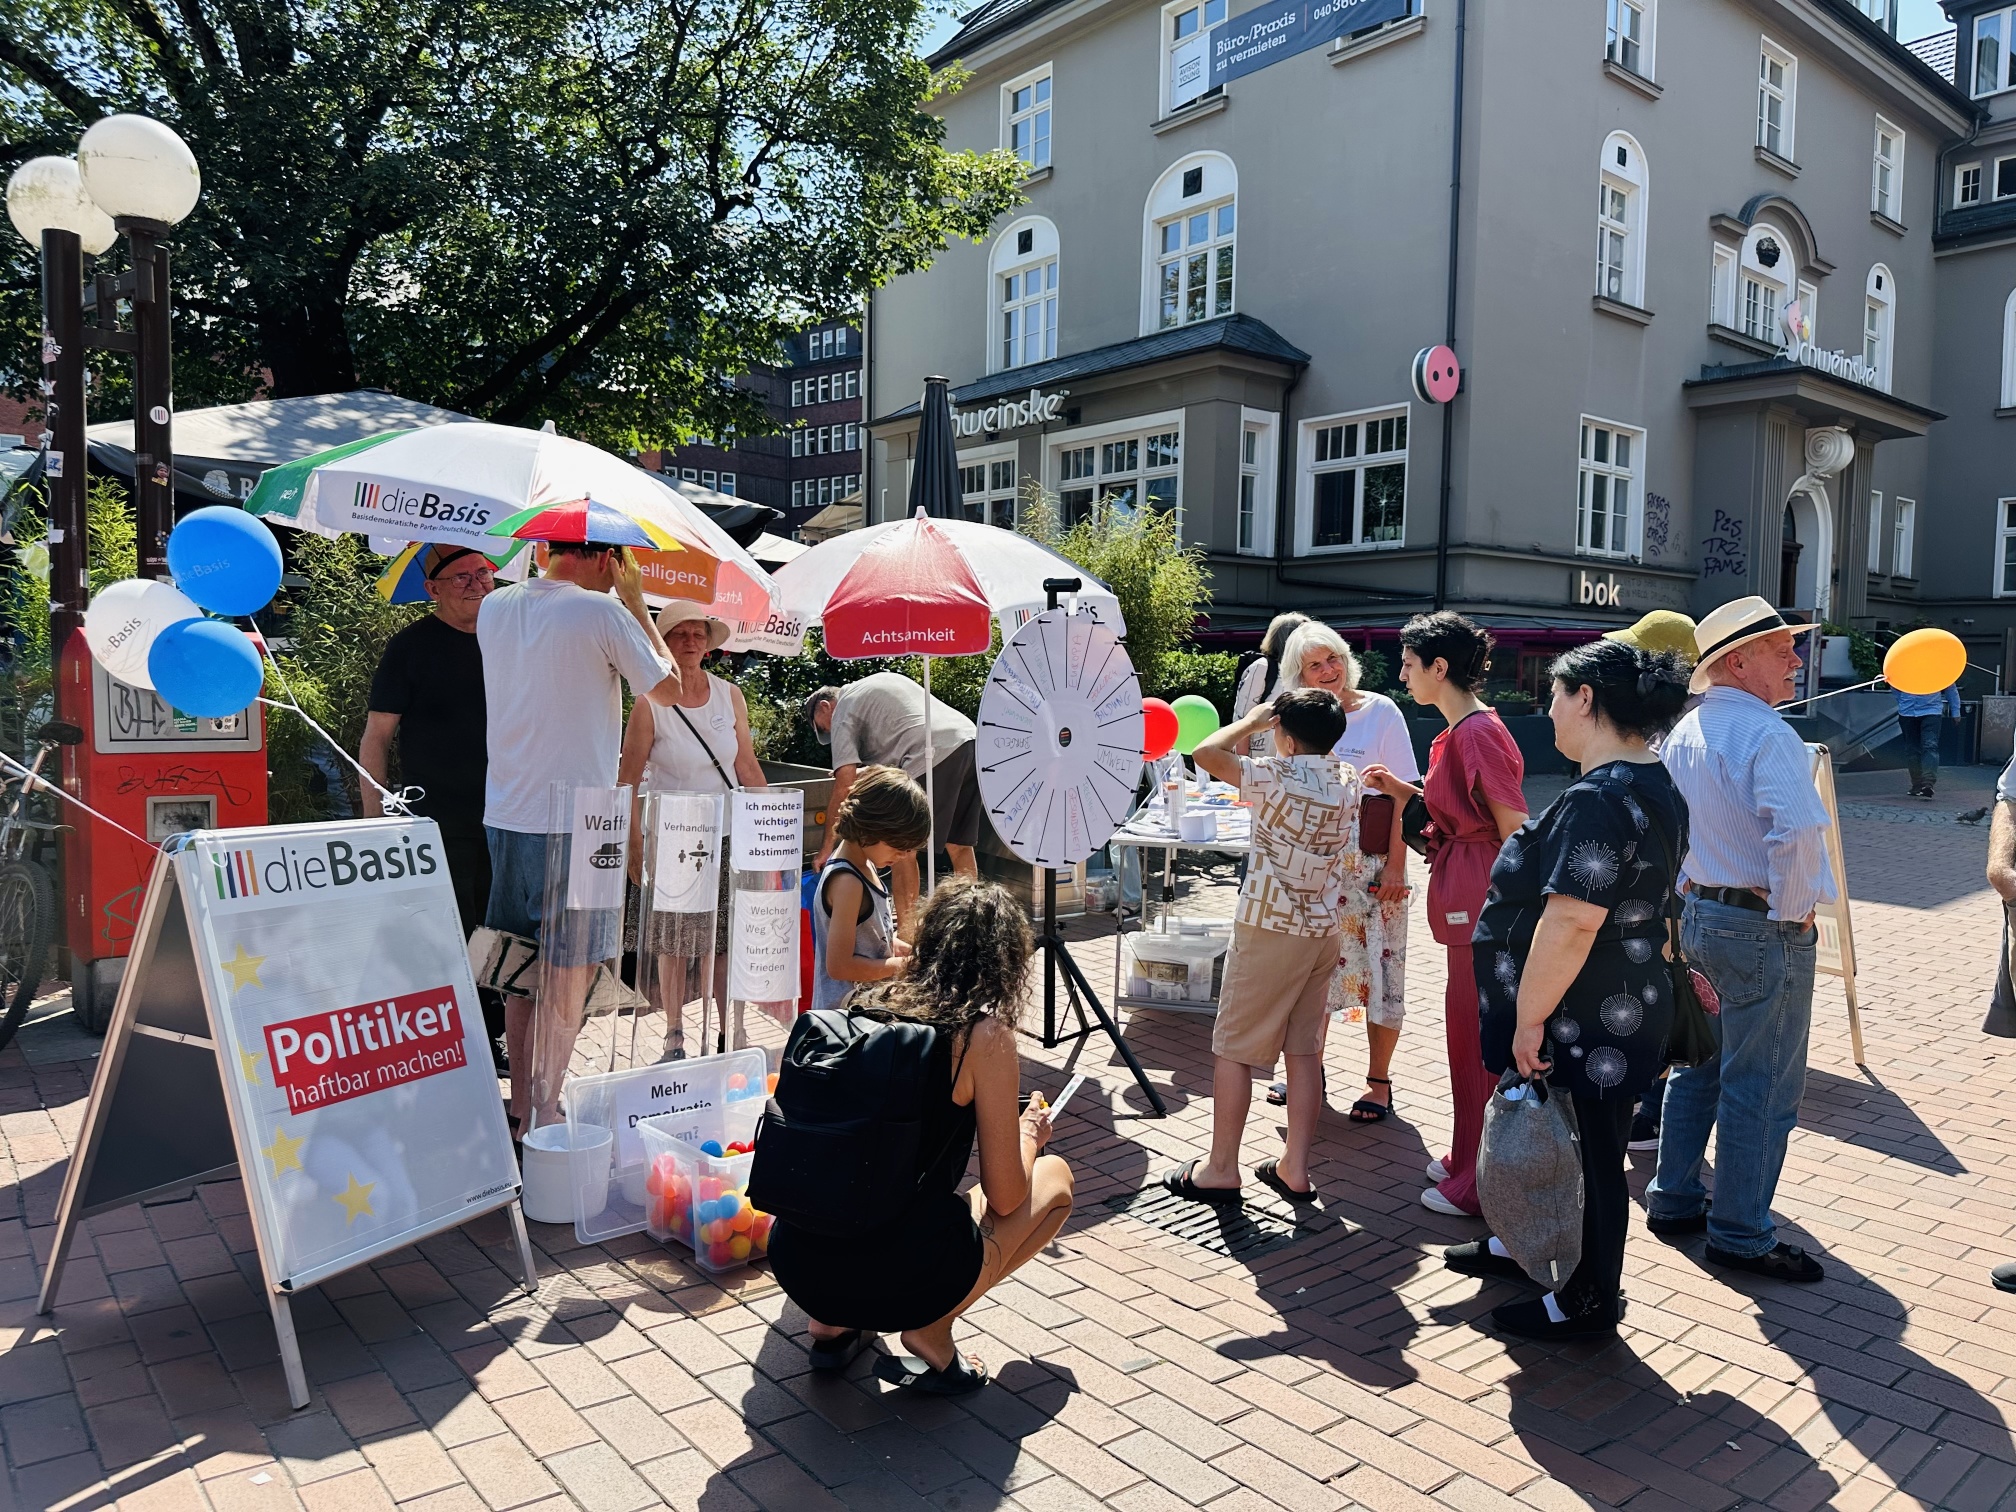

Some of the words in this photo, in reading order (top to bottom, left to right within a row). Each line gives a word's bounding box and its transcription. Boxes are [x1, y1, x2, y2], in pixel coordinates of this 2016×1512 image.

[1313, 3, 1331, 20] 040
[1216, 12, 1296, 56] Büro-/Praxis
[1216, 58, 1228, 72] zu
[1230, 33, 1287, 64] vermieten
[1179, 61, 1201, 77] AVISON
[1179, 69, 1201, 84] YOUNG
[381, 488, 491, 526] dieBasis
[351, 512, 419, 529] Basisdemokratische
[420, 522, 438, 533] Partei
[1580, 570, 1621, 607] bok
[861, 628, 956, 645] Achtsamkeit
[745, 802, 759, 811] Ich
[761, 802, 795, 811] möchte
[754, 817, 798, 828] wichtigen
[758, 832, 795, 842] Themen
[265, 836, 437, 893] dieBasis
[751, 906, 789, 915] Welcher
[745, 924, 766, 935] Weg
[746, 945, 769, 955] führt
[771, 946, 790, 955] zum
[750, 962, 785, 972] Frieden
[764, 980, 770, 988] ?
[271, 1001, 453, 1074] Politiker
[290, 1069, 370, 1108] haftbar
[377, 1041, 463, 1084] machen!
[651, 1081, 688, 1099] Mehr
